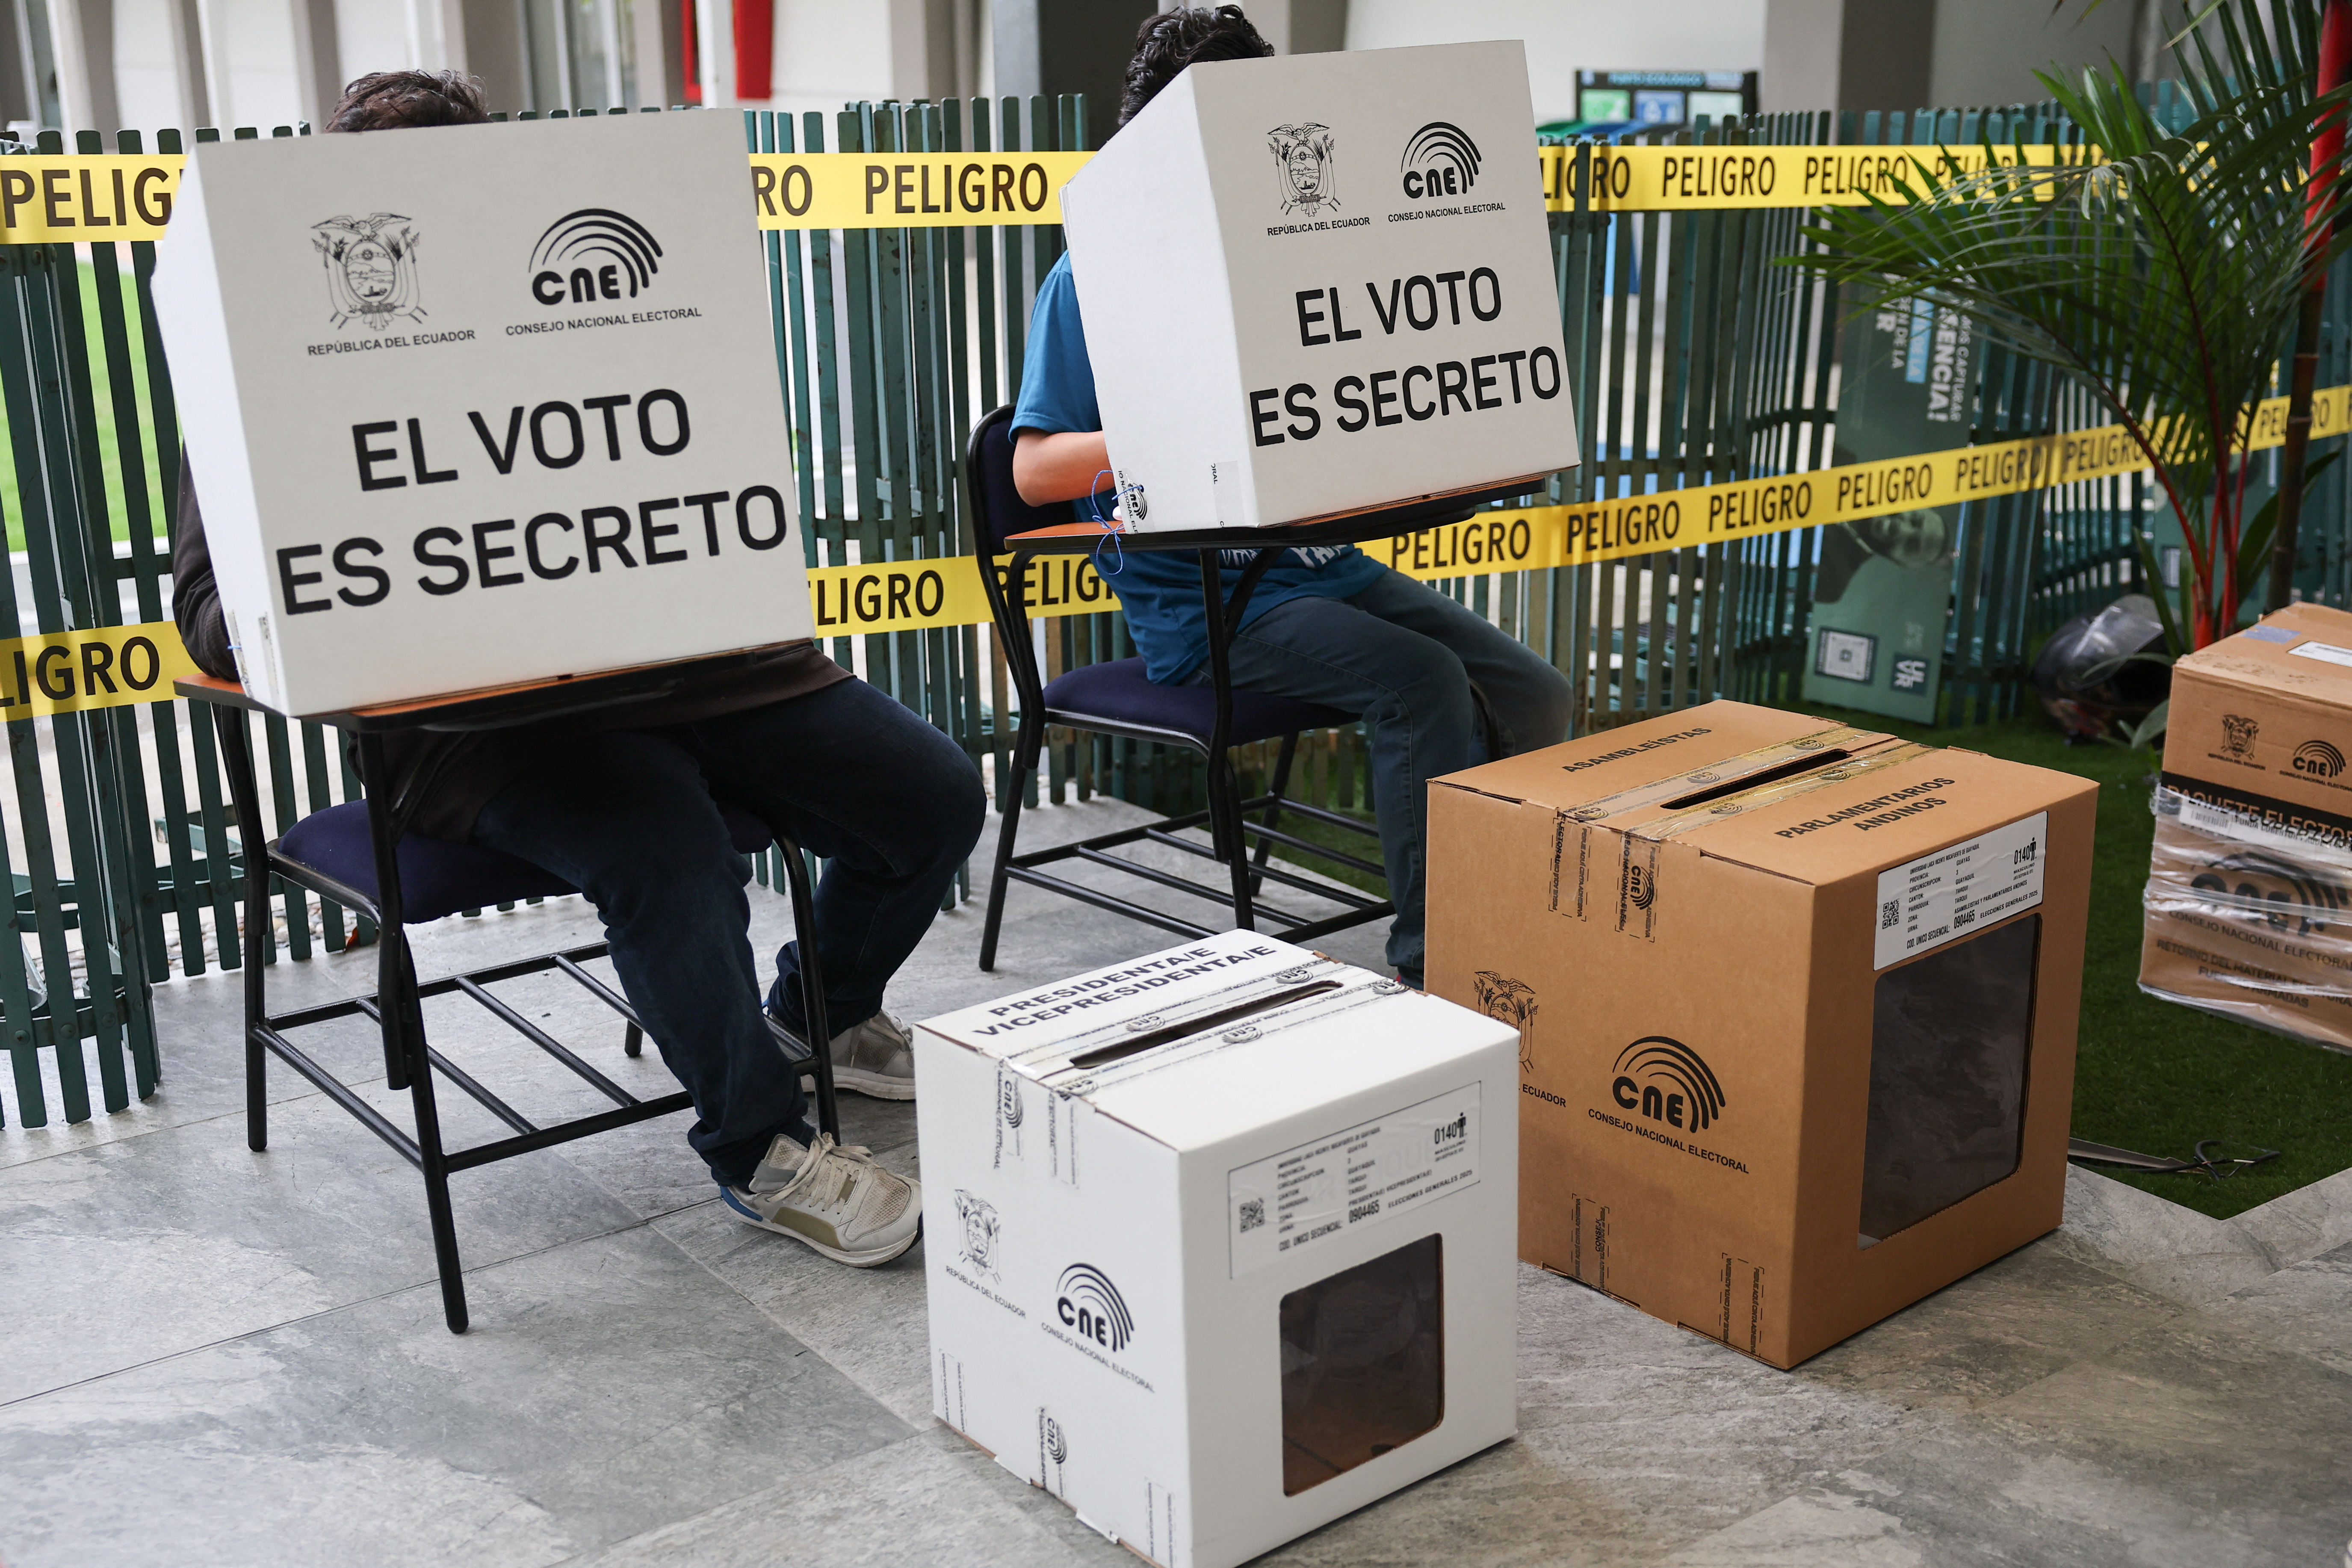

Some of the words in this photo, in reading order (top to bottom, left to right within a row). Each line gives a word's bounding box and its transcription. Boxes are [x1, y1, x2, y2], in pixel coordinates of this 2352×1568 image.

[865, 162, 1048, 214] PELIGRO
[1663, 155, 1776, 197] PELIGRO
[1804, 155, 1907, 195] PELIGRO
[2, 167, 172, 228] PELIG
[1387, 210, 1424, 223] CONSEJO
[1425, 207, 1462, 219] NACIONAL
[1463, 202, 1506, 216] ELECTORAL
[1267, 223, 1313, 236] REPÚBLICA
[1315, 221, 1330, 231] DEL
[1331, 217, 1371, 230] ECUADOR
[505, 320, 564, 336] CONSEJO
[567, 315, 629, 331] NACIONAL
[632, 307, 702, 323] ELECTORAL
[1295, 287, 1362, 347] EL
[1366, 267, 1502, 335] VOTO
[307, 339, 382, 356] REPÚBLICA
[384, 335, 410, 348] DEL
[413, 330, 476, 346] ECUADOR
[1249, 383, 1321, 447] ES
[1334, 345, 1562, 433] SECRETO
[352, 418, 459, 492] EL
[467, 389, 691, 475] VOTO
[1392, 519, 1531, 570] PELIGRO
[1566, 500, 1680, 555] PELIGRO
[1709, 481, 1813, 532] PELIGRO
[1837, 463, 1932, 511] PELIGRO
[1955, 446, 2042, 492] PELIGRO
[276, 537, 391, 616] ES
[413, 485, 788, 596] SECRETO
[816, 570, 944, 626] LIGRO
[1561, 728, 1712, 772] ASAMBLEÍSTAS
[2327, 781, 2352, 791] ELECTORA
[1774, 778, 1956, 839] PARLAMENTARIOS
[1853, 797, 1947, 831] ANDINOS
[1909, 872, 1929, 884] PROVINCIA:
[1956, 856, 1970, 866] GUAYAS
[1935, 856, 1945, 865] VICENTE
[2013, 862, 2035, 874] MASCULINO
[2014, 845, 2030, 865] 0140
[1908, 901, 1930, 913] PARROQUIA:
[1956, 885, 1968, 895] TARQUI
[1909, 877, 1941, 893] CIRCUNSCRIPCION:
[1909, 892, 1924, 903] CANTON:
[1956, 873, 1975, 885] GUAYAQUIL
[1908, 924, 1919, 933] URNA:
[1954, 899, 1980, 914] ASAMBLEISTAS
[1983, 886, 2012, 902] PARLAMENTARIOS
[2013, 880, 2027, 891] ANDINOS
[1908, 914, 1919, 923] ZONA:
[1955, 894, 1968, 904] TARQUI
[1916, 933, 1927, 946] UNICO
[1928, 924, 1950, 941] SECUENCIAL:
[1954, 909, 1975, 929] 0904465
[1980, 904, 2004, 918] ELECCIONES
[2005, 894, 2028, 908] GENERALES
[2028, 889, 2038, 898] 2025
[2169, 911, 2219, 933] CONSEJO
[2222, 925, 2281, 953] NACIONAL
[973, 946, 1277, 1036] VICEPRESIDENTA/E
[988, 947, 1217, 1016] PRESIDENTA/E
[1522, 1084, 1566, 1108] ECUADOR
[1434, 1121, 1457, 1145] 0140
[1588, 1108, 1633, 1132] CONSEJO
[1635, 1125, 1686, 1152] NACIONAL
[1688, 1144, 1749, 1174] ELECTORAL
[1388, 1189, 1424, 1208] ELECCIONES
[1424, 1175, 1458, 1193] GENERALES
[946, 1265, 980, 1291] REPÚBLICA
[981, 1286, 993, 1299] DEL
[995, 1295, 1026, 1319] ECUADOR
[1041, 1322, 1073, 1346] CONSEJO
[1075, 1340, 1111, 1368] NACIONAL
[1112, 1362, 1155, 1393] ELECTORAL
